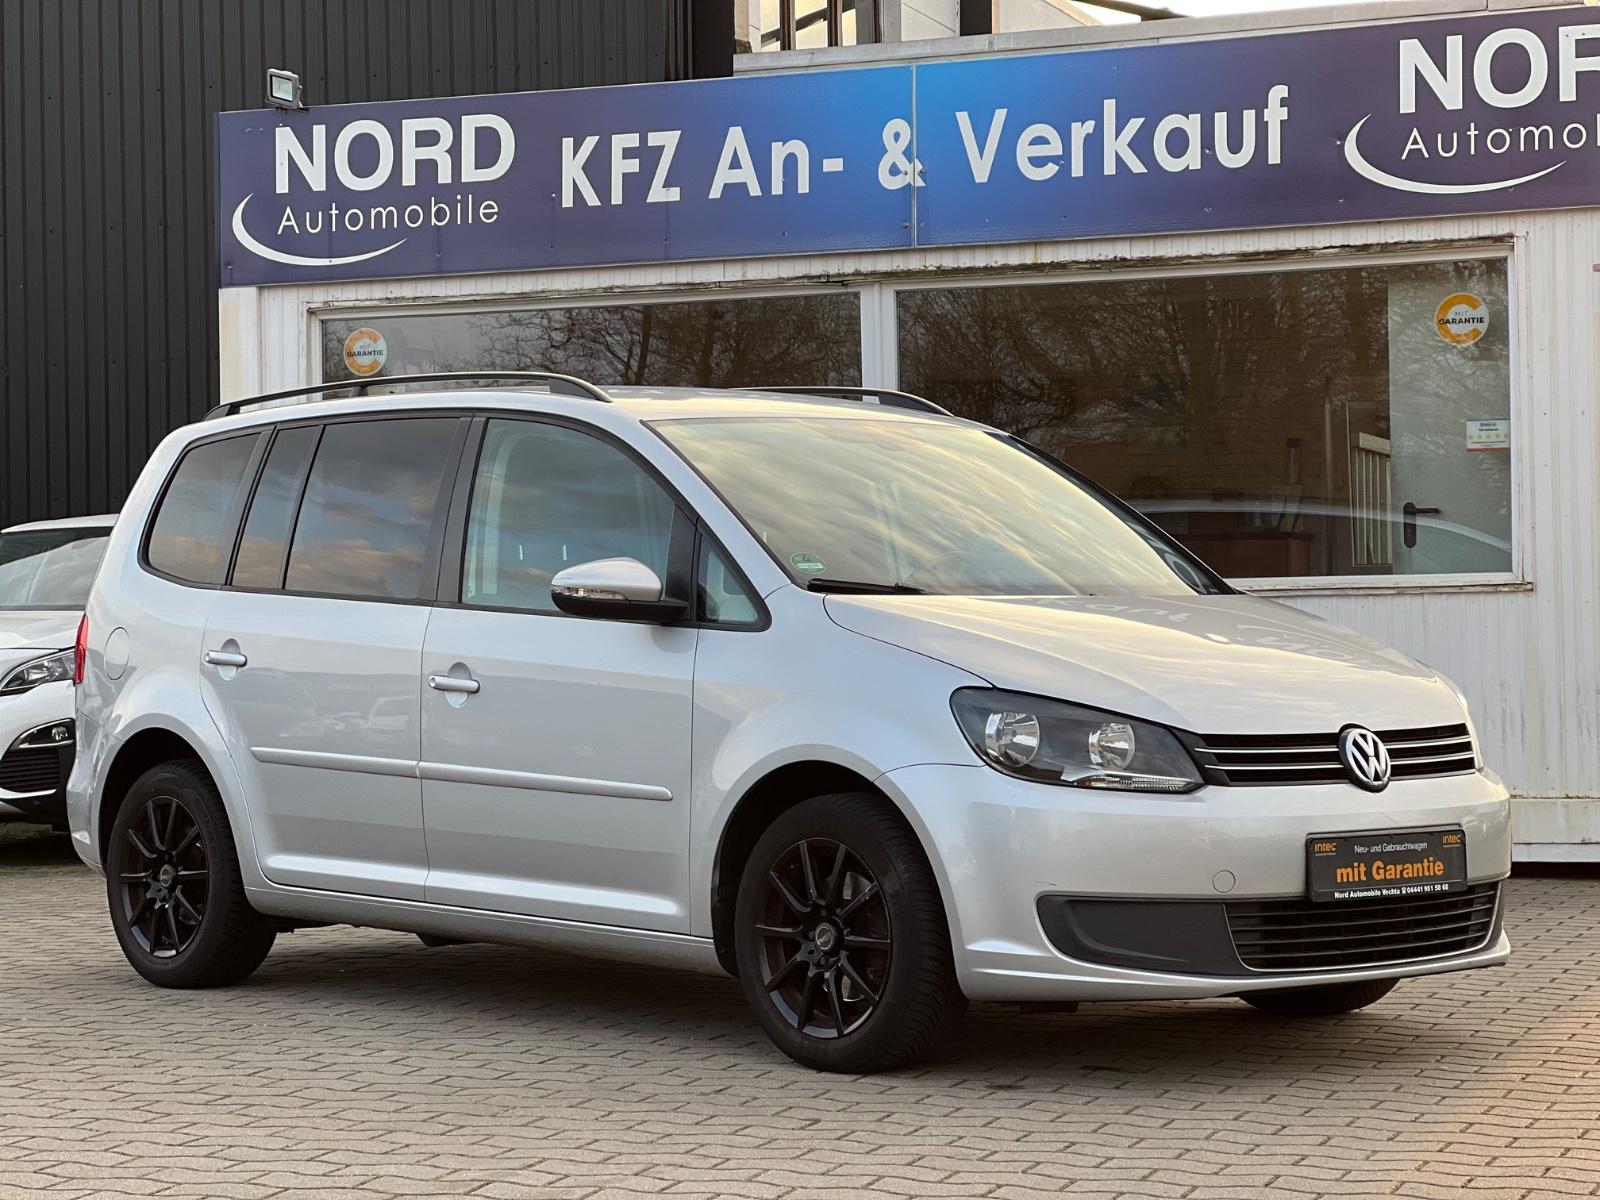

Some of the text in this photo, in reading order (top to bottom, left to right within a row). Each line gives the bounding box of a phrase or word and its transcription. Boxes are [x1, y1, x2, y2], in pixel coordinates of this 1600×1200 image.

[561, 84, 1289, 208] KFZ An- & Verkauf
[1401, 113, 1600, 160] Automo
[275, 113, 516, 194] NORD
[277, 194, 499, 235] Automobile
[1438, 316, 1485, 326] GARANTIE
[346, 349, 384, 358] GARANTIE
[1354, 842, 1428, 853] Neu- und Gebrauchtwagen
[1336, 856, 1444, 883] mit Garantie
[1334, 891, 1349, 899] Nord
[1350, 889, 1381, 898] Automobile
